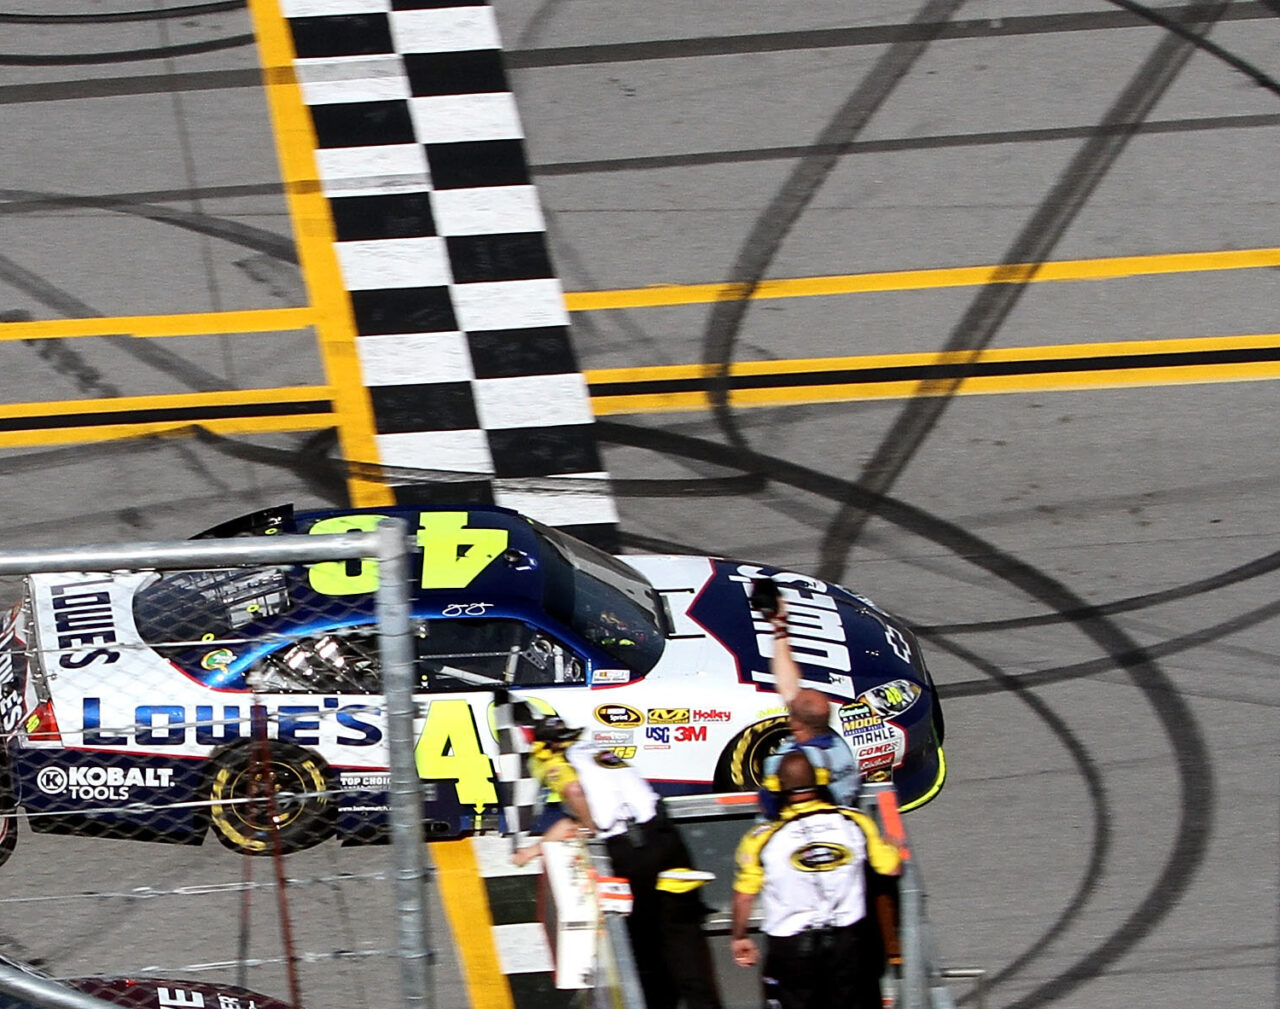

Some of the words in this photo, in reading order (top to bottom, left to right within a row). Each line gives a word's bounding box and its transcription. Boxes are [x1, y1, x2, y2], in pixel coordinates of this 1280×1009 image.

[82, 697, 384, 747] LOWE'S
[692, 709, 732, 722] Holley
[842, 715, 882, 731] MOOG
[646, 726, 670, 743] USG
[674, 726, 707, 742] 3M
[853, 726, 896, 746] MAHLE
[858, 743, 892, 757] COMP
[69, 766, 175, 788] KOBALT
[340, 777, 361, 786] TOP
[362, 776, 392, 786] CHOIC
[69, 786, 130, 800] TOOLS
